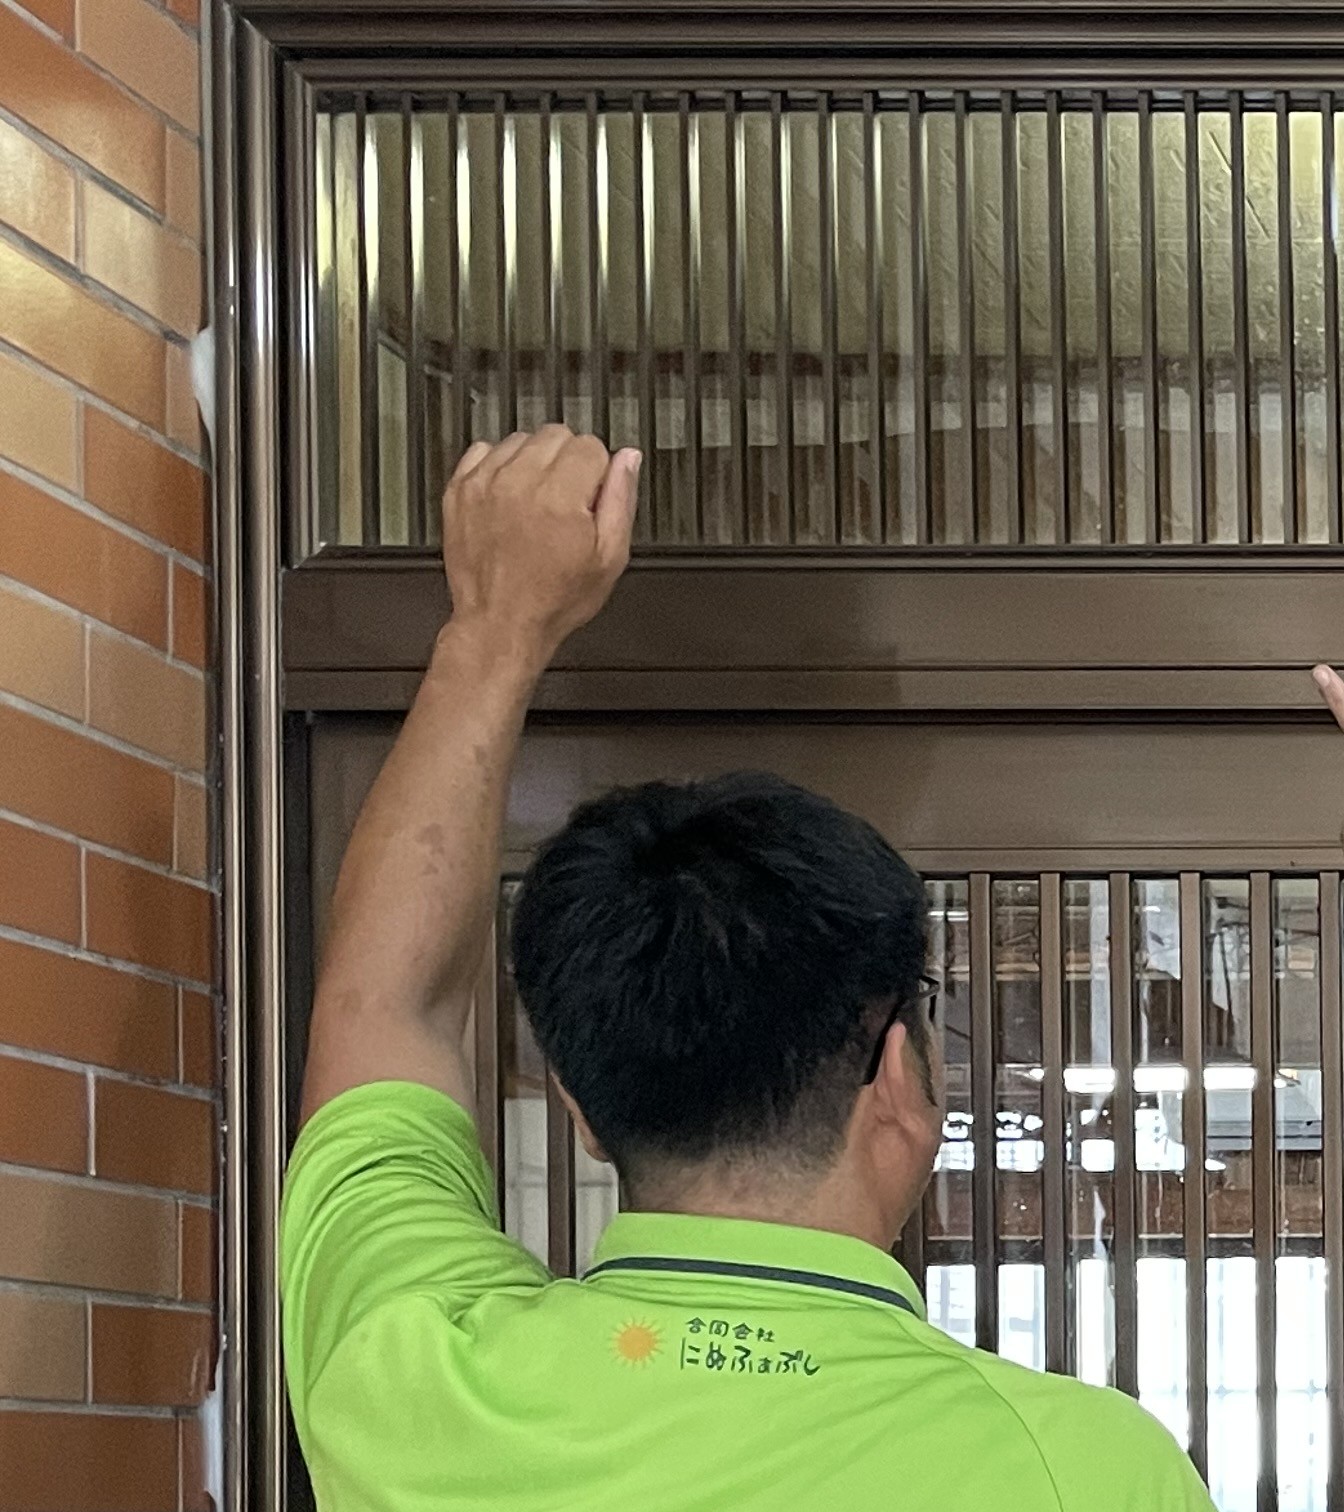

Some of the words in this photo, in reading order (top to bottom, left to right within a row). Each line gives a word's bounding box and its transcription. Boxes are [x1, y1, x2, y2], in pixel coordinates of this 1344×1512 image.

[685, 1316, 776, 1343] 合同会社
[680, 1337, 821, 1376] にぬふぁぶし
